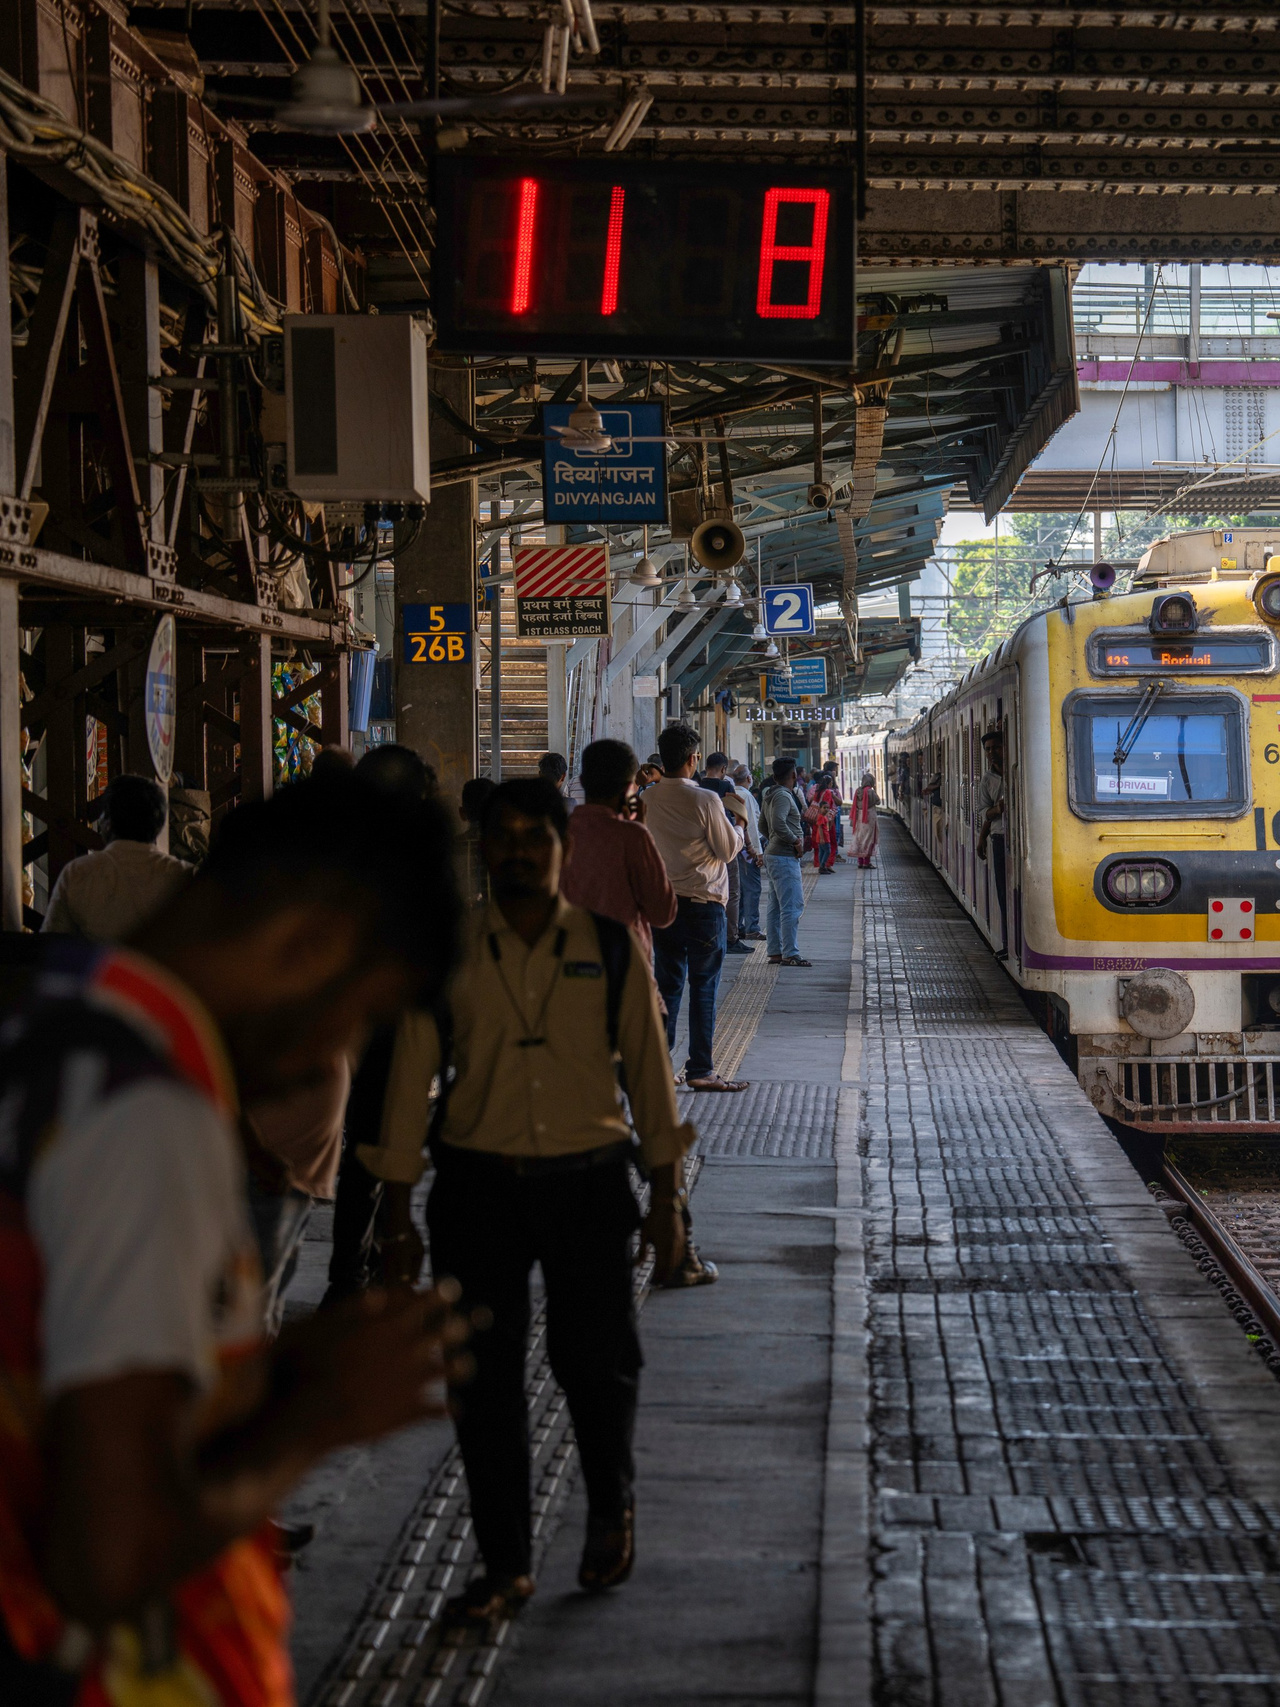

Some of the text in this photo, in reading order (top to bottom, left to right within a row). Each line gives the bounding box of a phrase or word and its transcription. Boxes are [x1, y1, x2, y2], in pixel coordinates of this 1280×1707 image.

[756, 187, 830, 319] 8
[553, 461, 655, 484] दिव्यांगजन
[554, 492, 656, 505] DIVYANGJAN
[522, 600, 551, 611] प्रथम
[553, 597, 571, 610] वर्ग
[772, 592, 803, 629] 2
[429, 606, 446, 632] 5
[522, 613, 550, 623] पहला
[526, 625, 601, 636] 1ST CLASS COACH
[411, 636, 466, 662] 26B
[1109, 780, 1156, 790] BORIVALI
